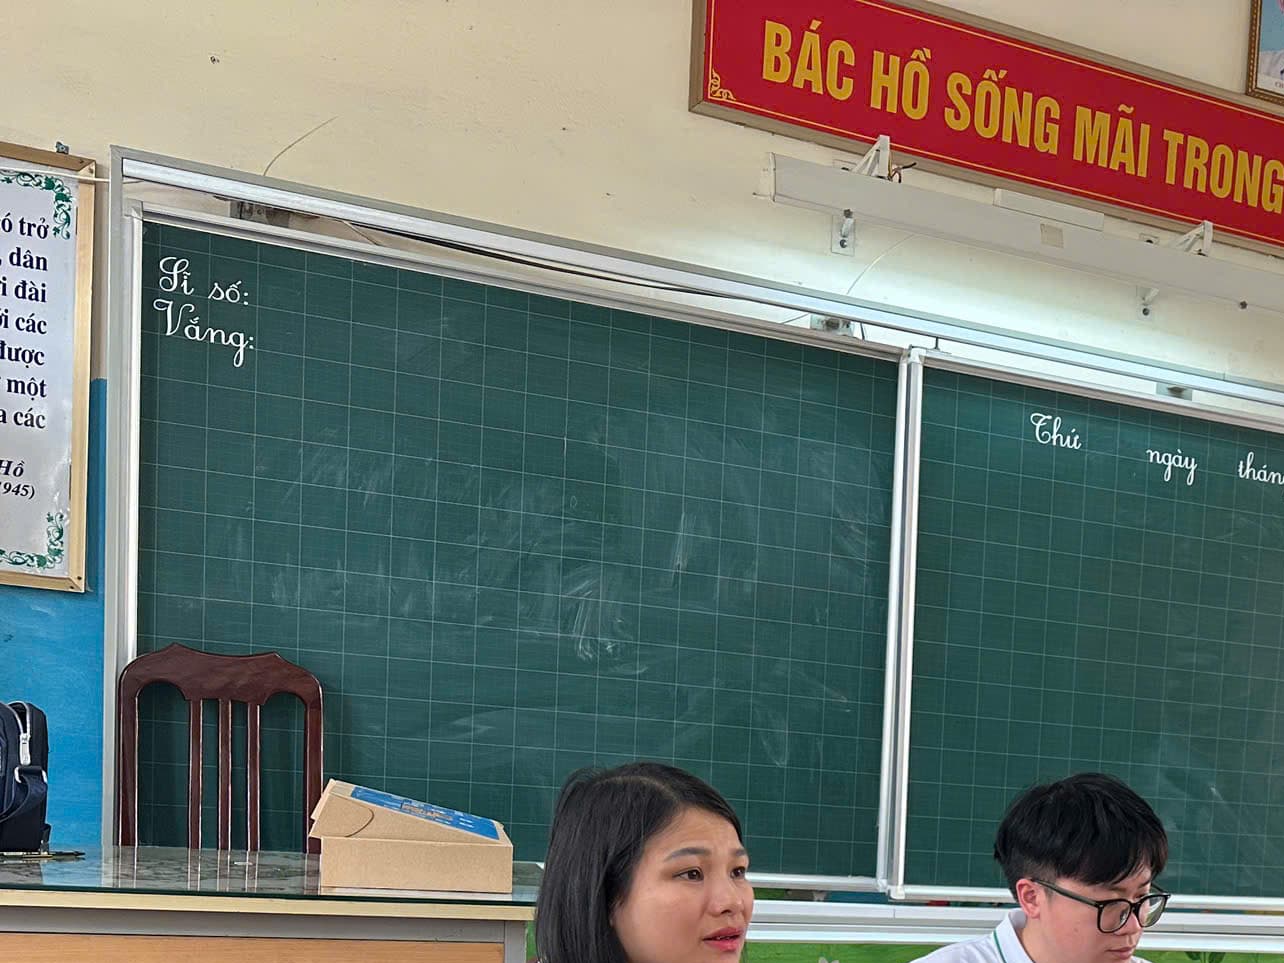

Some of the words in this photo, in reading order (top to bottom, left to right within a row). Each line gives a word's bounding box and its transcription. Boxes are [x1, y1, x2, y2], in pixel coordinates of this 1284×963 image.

[764, 20, 855, 100] BÁC
[871, 48, 932, 119] HỒ
[945, 69, 1059, 154] SỐNG
[1074, 104, 1150, 177] MÃI
[1163, 130, 1284, 211] TRONG
[19, 217, 49, 240] trở
[9, 246, 48, 272] dân
[14, 279, 47, 303] đài
[207, 279, 250, 306] số:
[15, 313, 47, 335] các
[152, 299, 255, 368] Vắng:
[7, 377, 47, 402] một
[13, 407, 46, 429] các
[1029, 412, 1082, 450] Thứ
[1146, 448, 1198, 486] ngày
